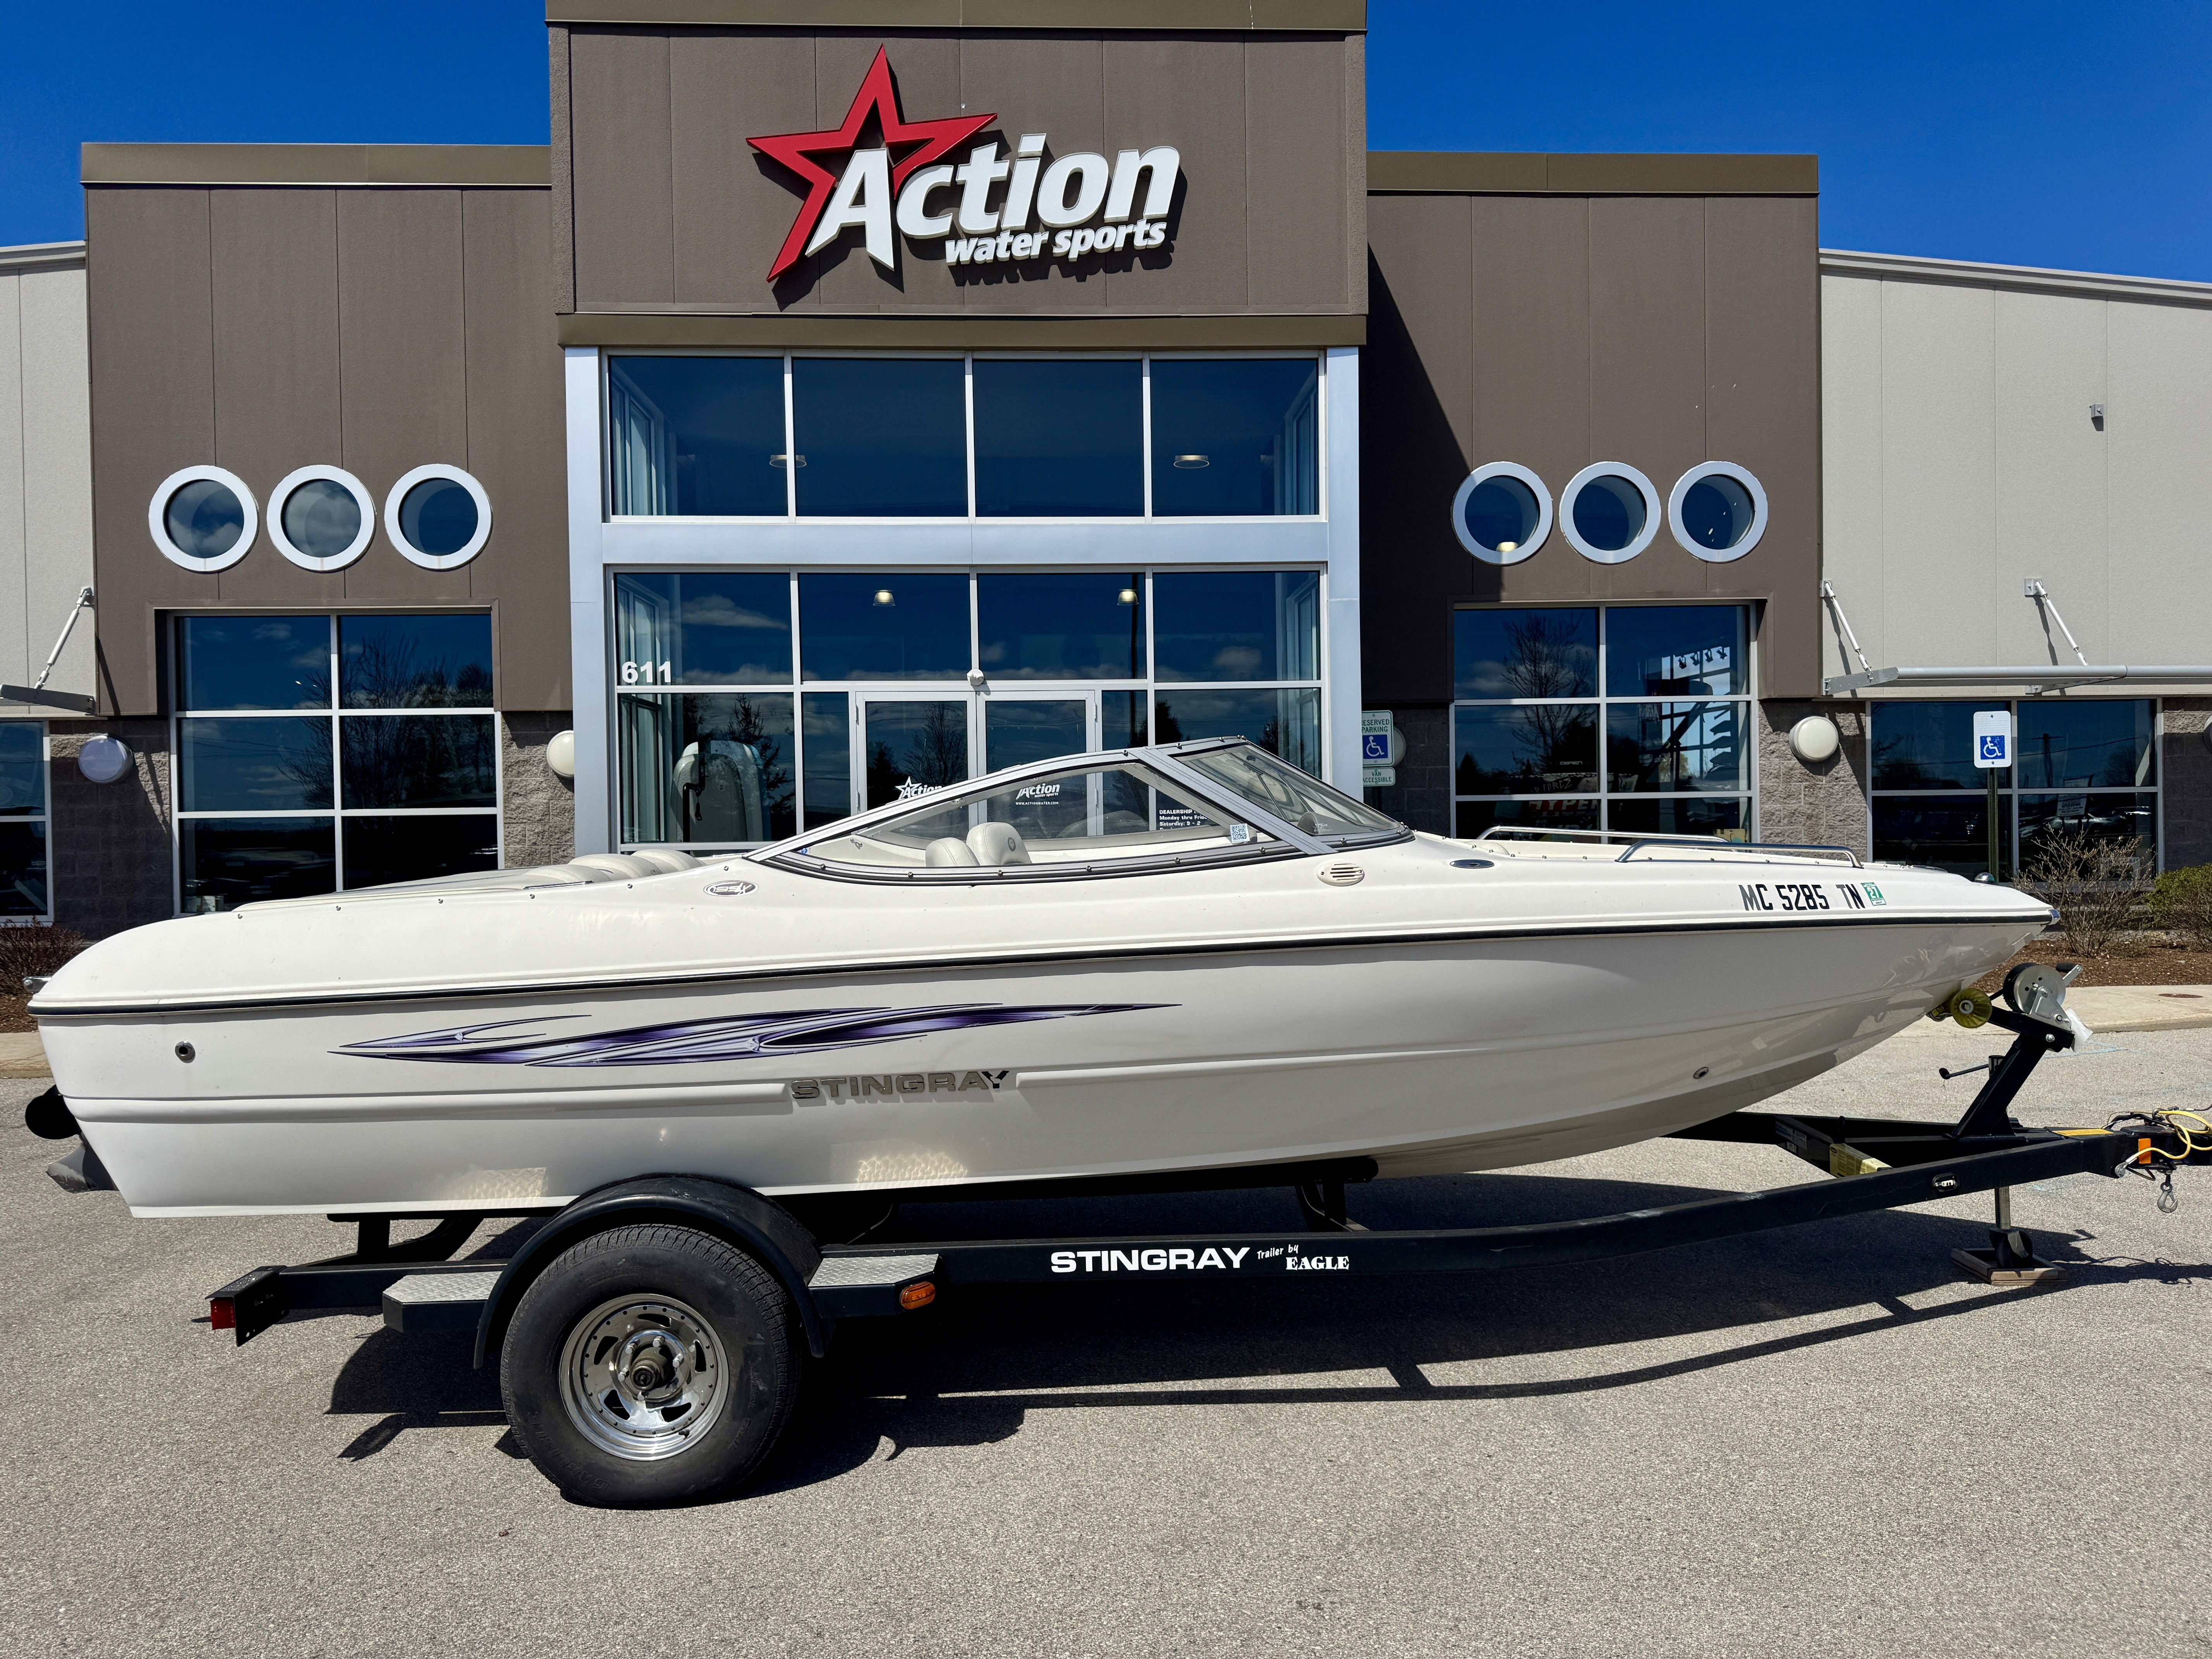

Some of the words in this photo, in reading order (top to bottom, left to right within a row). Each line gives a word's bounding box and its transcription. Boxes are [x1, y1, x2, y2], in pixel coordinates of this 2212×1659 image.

[805, 133, 1180, 270] Action
[945, 230, 1049, 266] water
[1052, 218, 1166, 261] sports
[622, 661, 671, 683] 611
[1020, 783, 1060, 799] Action
[1738, 884, 1773, 911] MC
[1775, 884, 1830, 911] 5285
[1835, 884, 1866, 909] TN
[1867, 886, 1880, 899] 27
[791, 1070, 1009, 1099] STINGRAY
[1051, 1247, 1250, 1273] STINGRAY
[1257, 1246, 1284, 1261] Trailer
[1288, 1243, 1299, 1255] by
[1285, 1256, 1350, 1270] EAGLE
